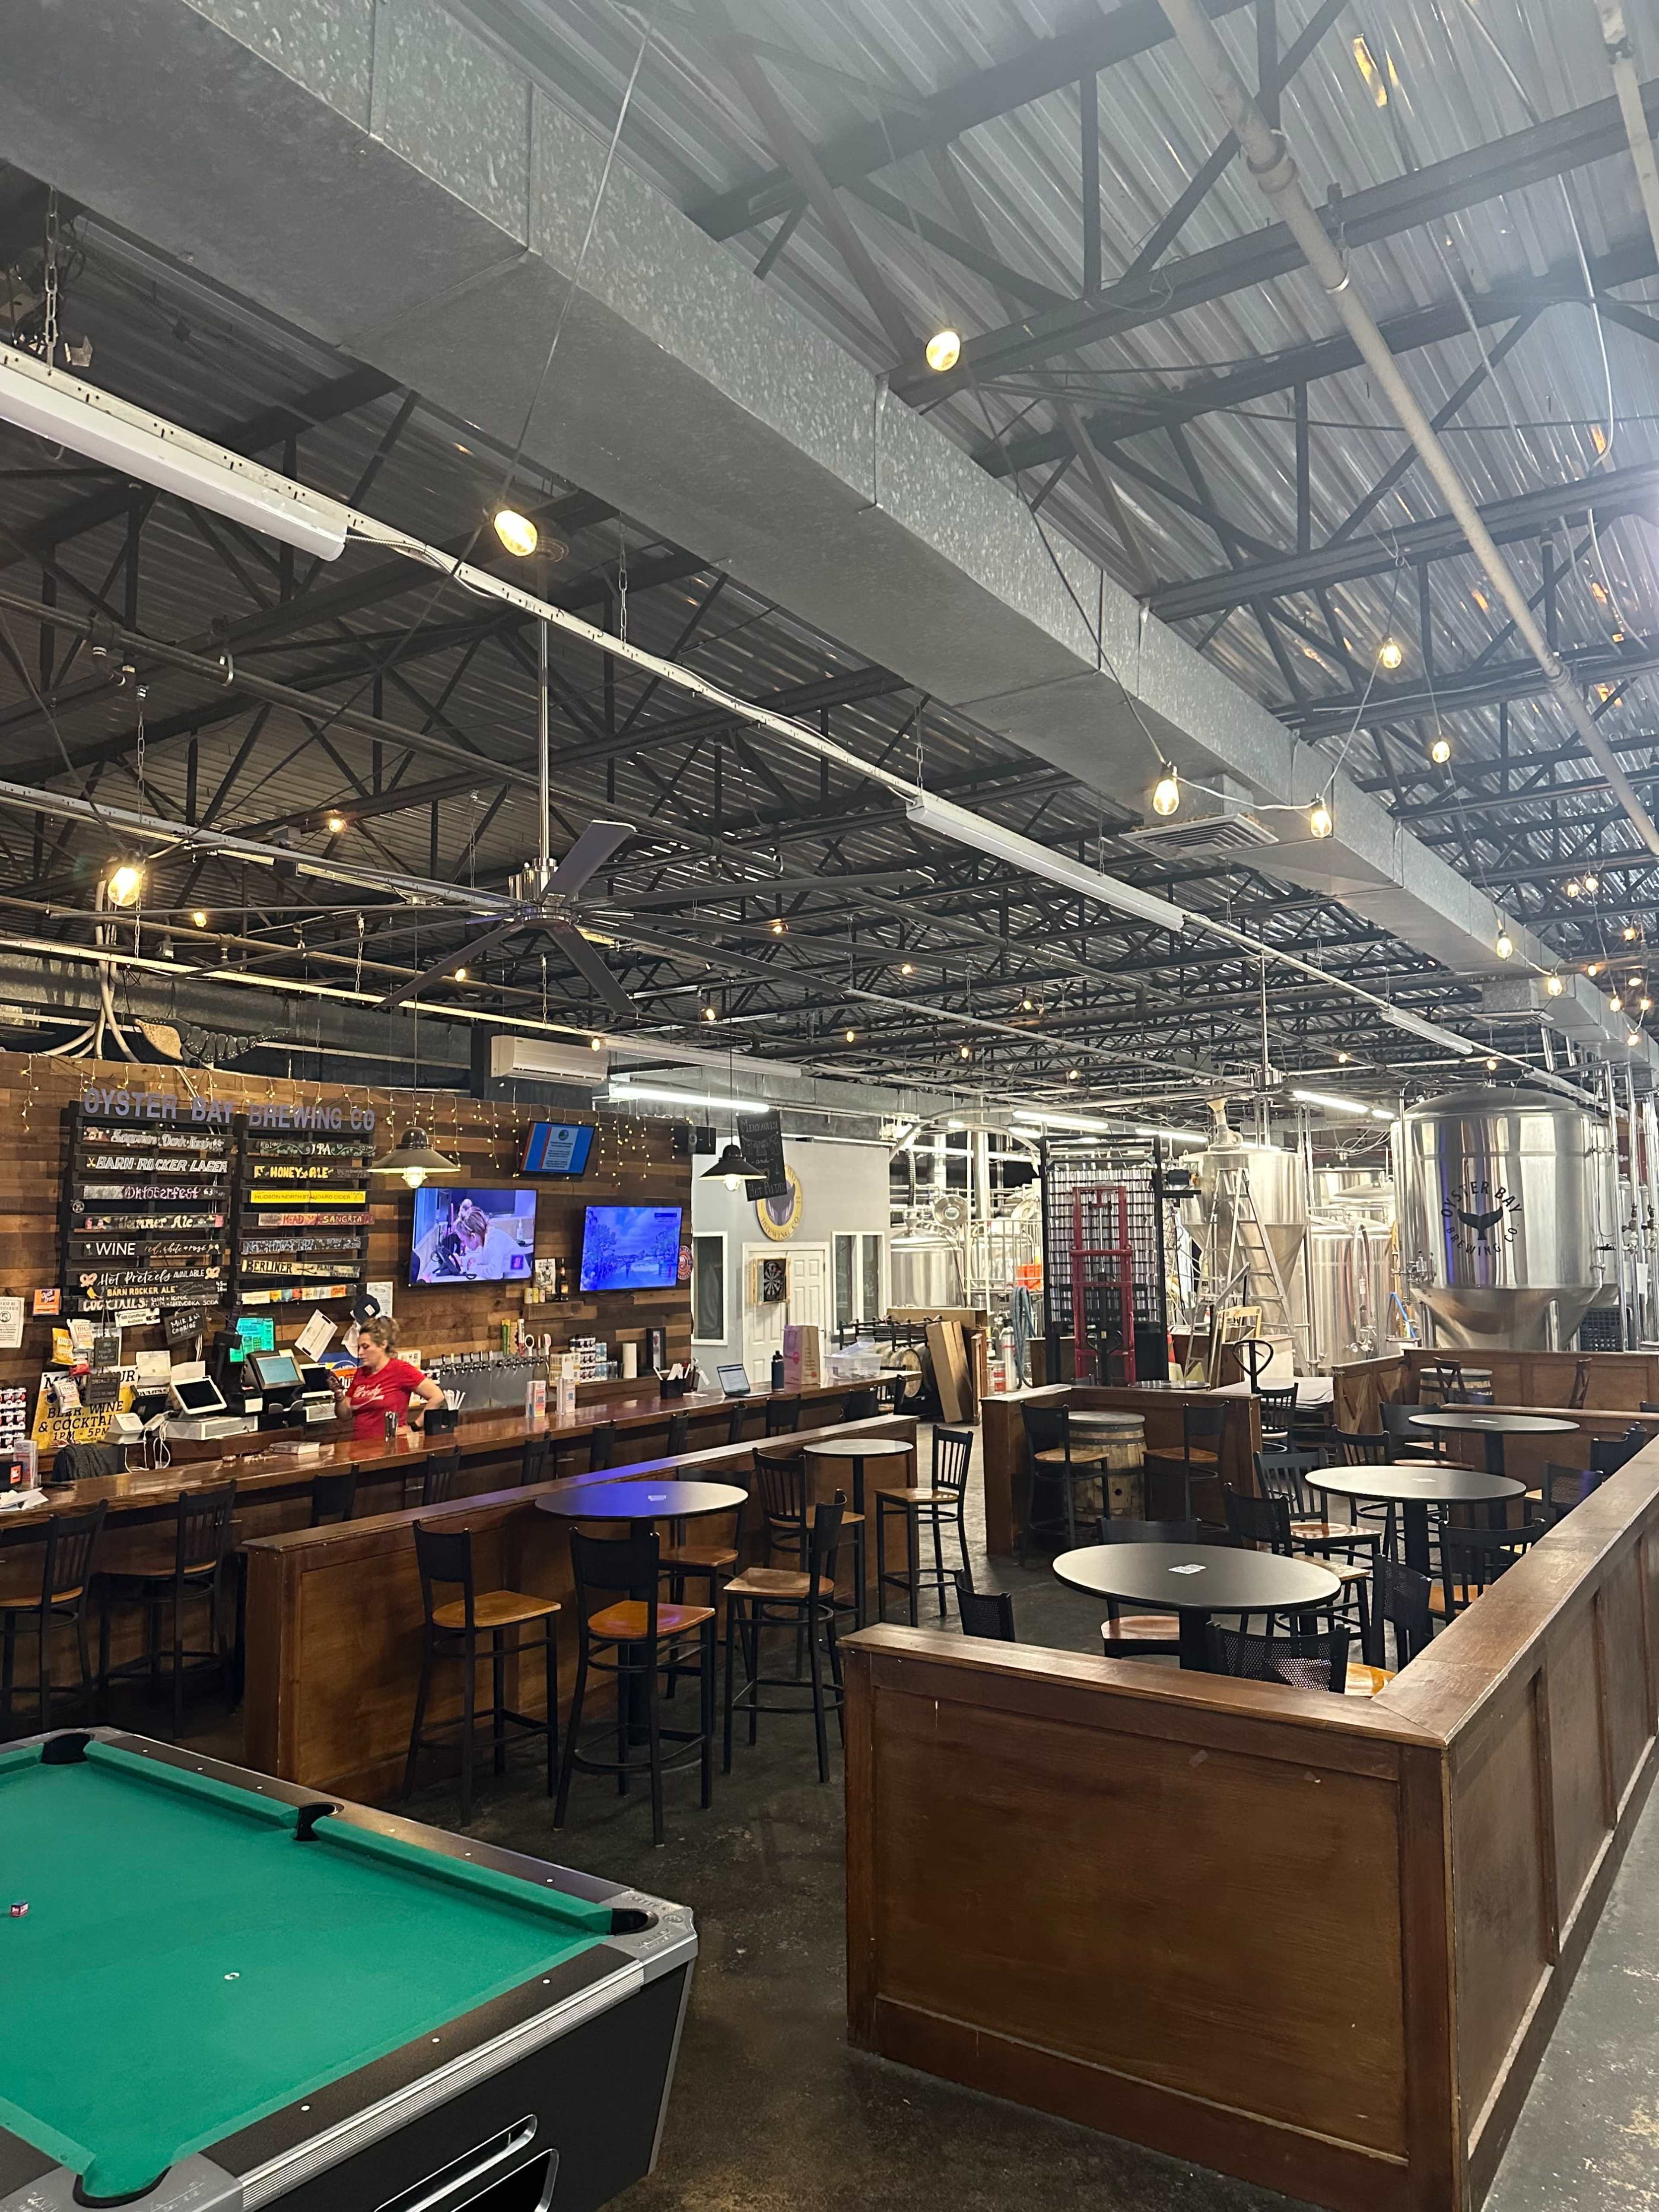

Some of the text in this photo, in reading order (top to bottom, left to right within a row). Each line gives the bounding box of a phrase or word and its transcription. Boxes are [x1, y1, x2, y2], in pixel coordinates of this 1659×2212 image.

[83, 1088, 375, 1131] OYSTER BAY BREWING CO
[95, 1156, 228, 1173] BARN ROCKER LAGER
[270, 1166, 303, 1178] HONEY
[308, 1166, 329, 1179] ALE
[1441, 1181, 1522, 1217] OYSTER BAY
[171, 1215, 194, 1229] Ale
[283, 1214, 362, 1224] MEAD SANGRIA
[1446, 1226, 1501, 1256] BREWING
[95, 1242, 136, 1255] WINE
[247, 1260, 293, 1273] BERLINER
[97, 1269, 205, 1286] Hot Pretzels AVAILABLE
[107, 1285, 176, 1297] BARN ROCKER ALE
[89, 1401, 124, 1414] WINE
[39, 1414, 112, 1433] & COCKTAI
